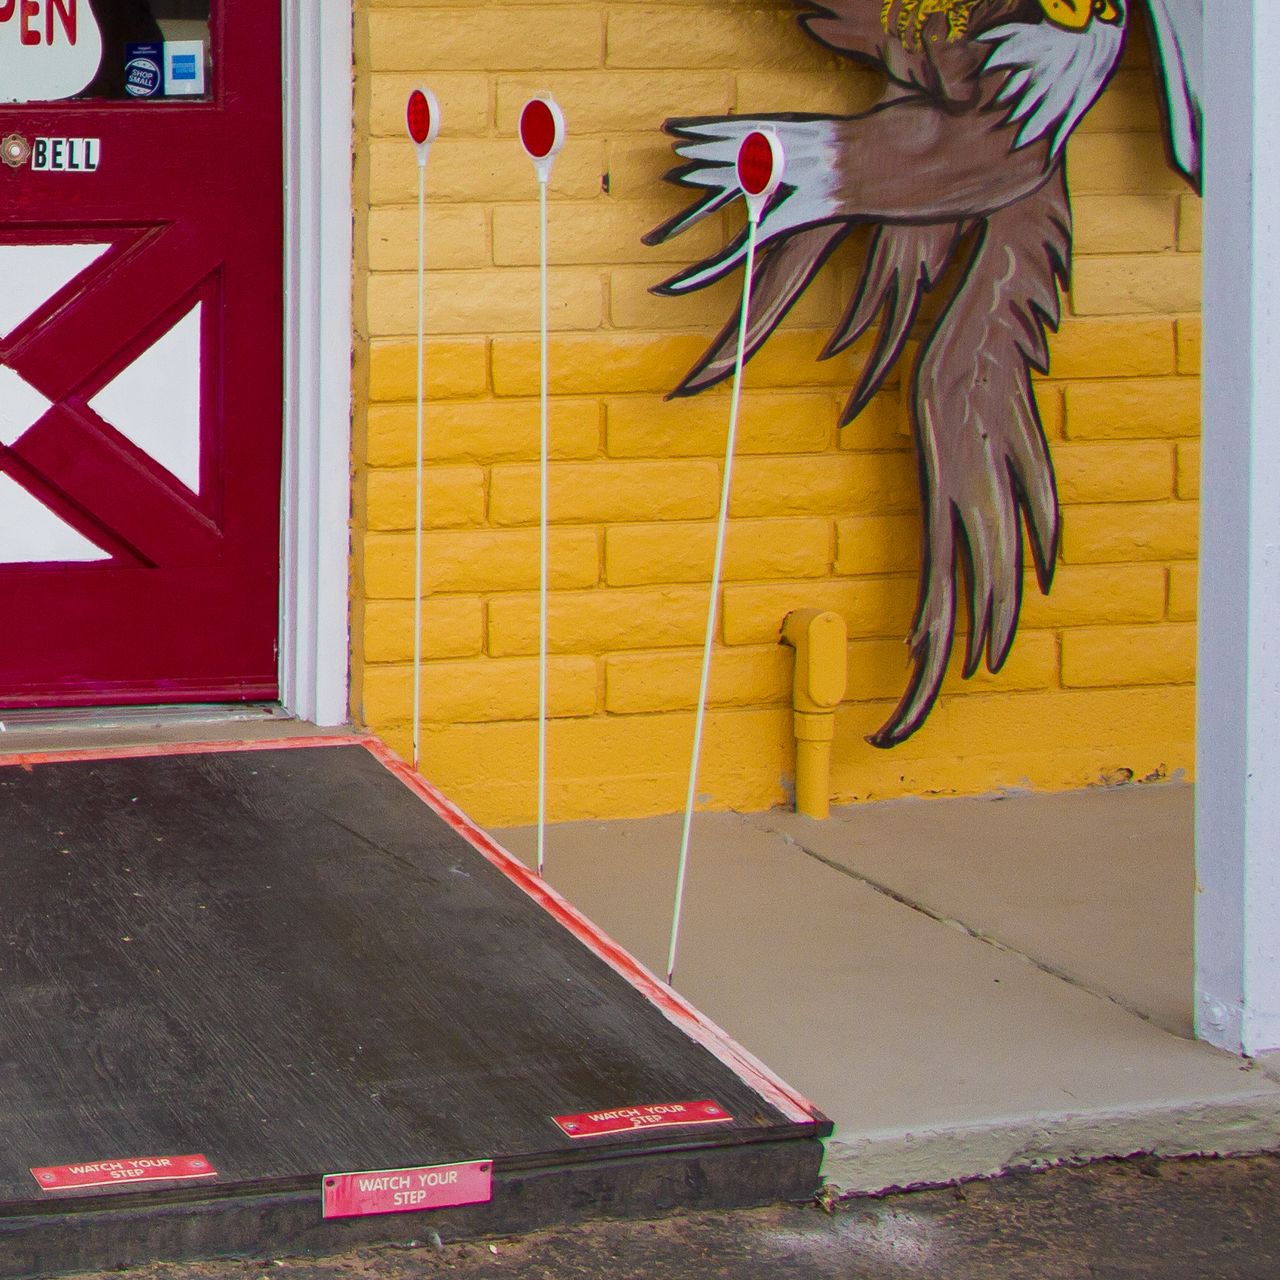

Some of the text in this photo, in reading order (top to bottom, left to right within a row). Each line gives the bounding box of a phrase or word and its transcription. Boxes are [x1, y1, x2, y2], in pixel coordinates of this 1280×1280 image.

[128, 75, 153, 86] SMALL
[132, 68, 153, 78] SHOP
[34, 139, 96, 169] BELL
[588, 1104, 686, 1122] WATCH YOUR
[629, 1115, 662, 1125] STEP
[68, 1158, 172, 1175] WATCH YOUR
[110, 1169, 145, 1179] STEP
[359, 1171, 458, 1192] WATCH YOUR
[393, 1190, 427, 1206] STEP
